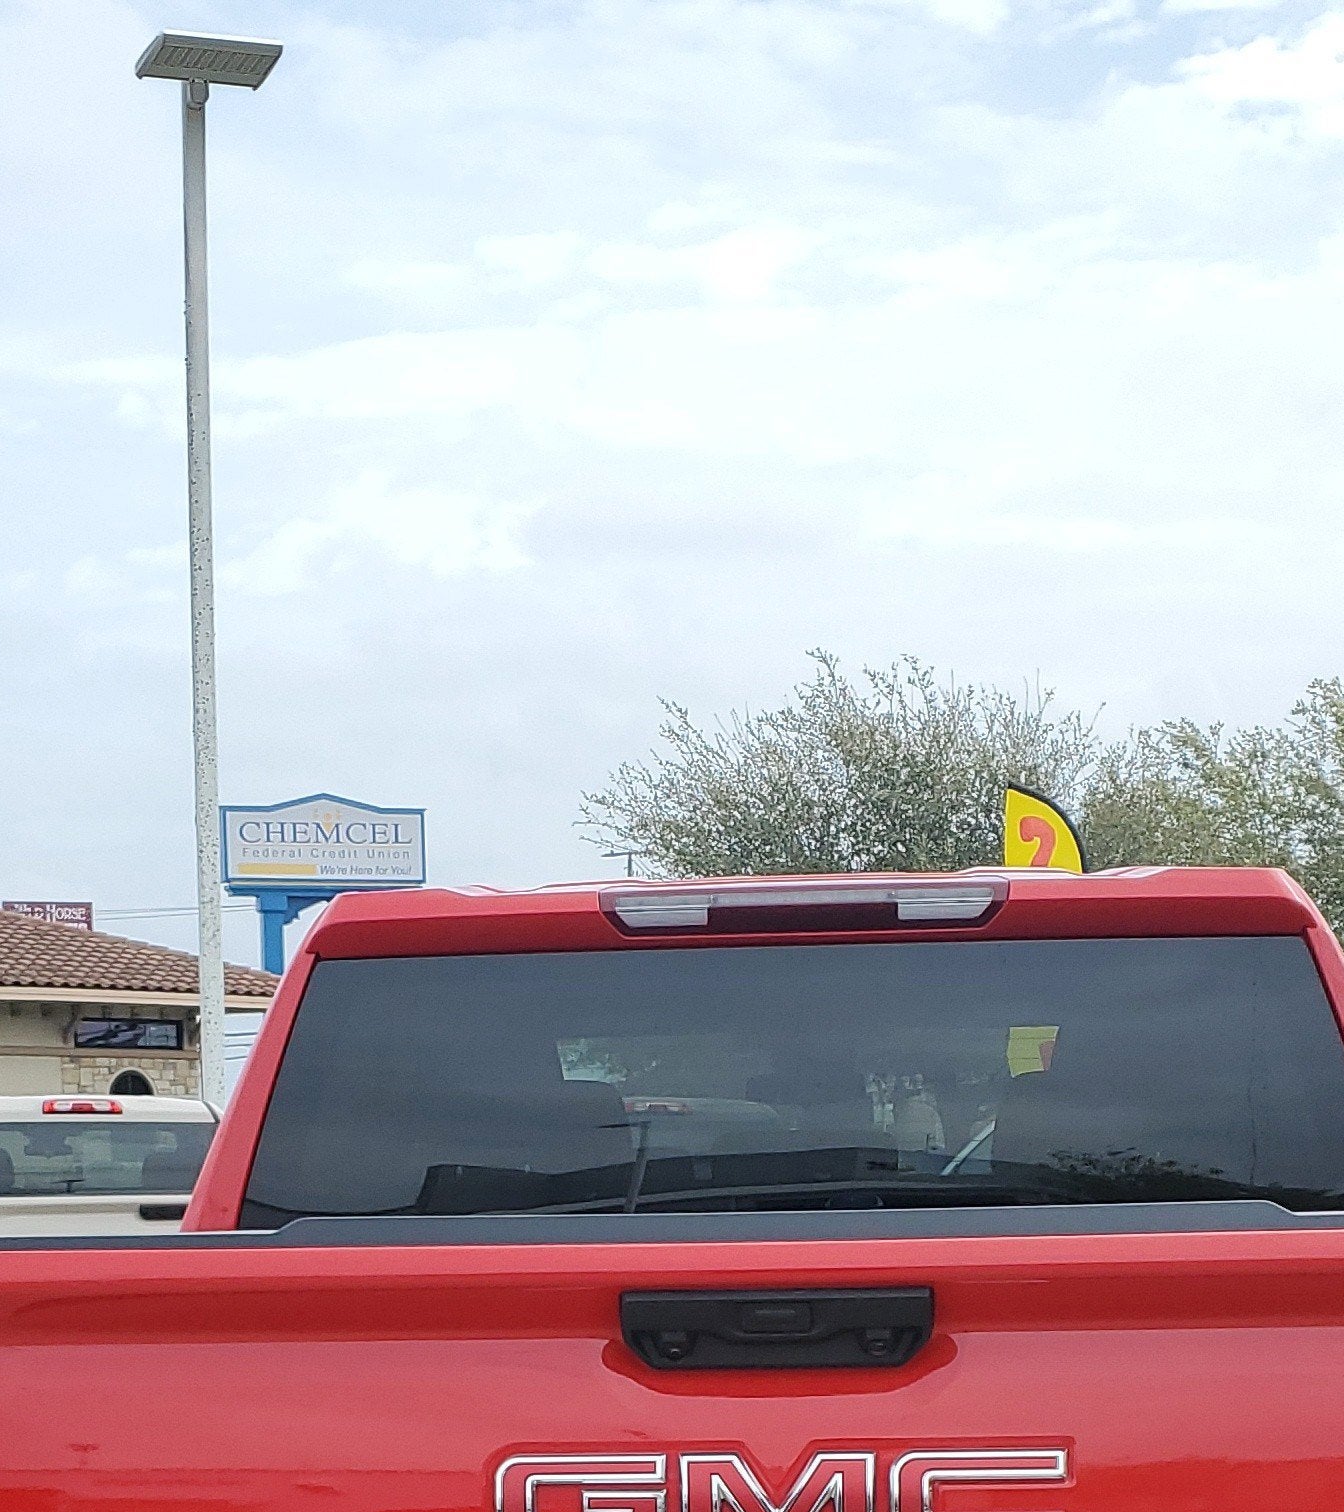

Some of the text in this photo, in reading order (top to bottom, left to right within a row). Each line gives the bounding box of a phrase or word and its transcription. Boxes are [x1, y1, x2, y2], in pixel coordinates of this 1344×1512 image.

[239, 821, 412, 844] CHEMCEL
[242, 848, 410, 859] Federal Credit Union
[320, 865, 412, 875] We're Here for You!
[46, 904, 86, 922] HORSE
